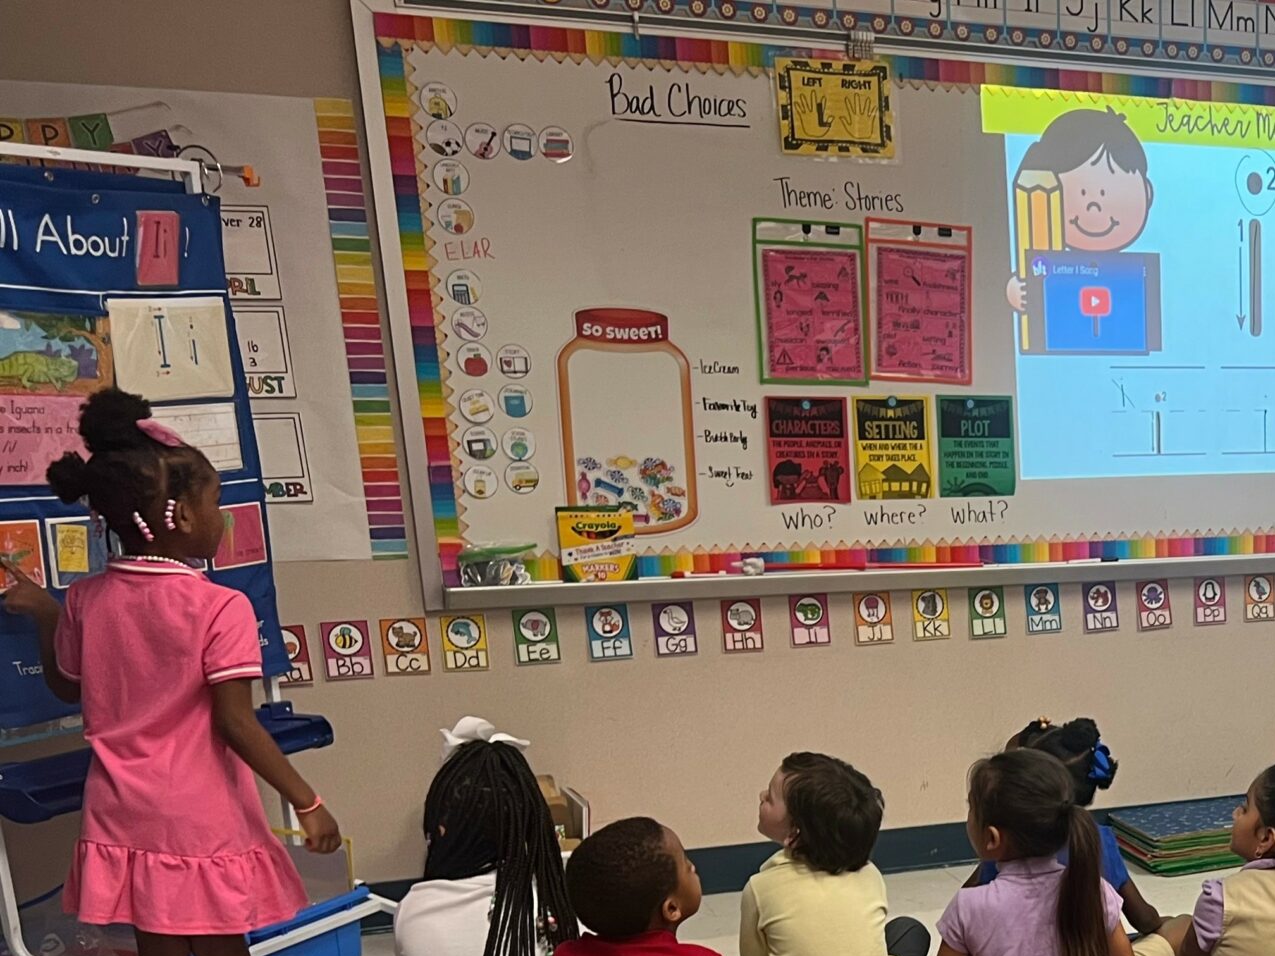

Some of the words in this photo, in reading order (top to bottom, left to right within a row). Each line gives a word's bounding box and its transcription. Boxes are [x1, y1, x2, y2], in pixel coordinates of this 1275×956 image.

[1119, 0, 1153, 25] Kk
[1208, 7, 1255, 33] Mm
[802, 76, 823, 88] LEFT
[841, 79, 873, 91] RIGHT
[605, 73, 661, 118] Bad
[667, 82, 749, 119] Choices
[1156, 102, 1252, 138] Teacher
[773, 176, 838, 210] Theme:
[844, 181, 904, 213] Stories
[249, 216, 263, 229] 28
[35, 213, 130, 257] About
[444, 237, 495, 261] ELAR
[1053, 265, 1074, 275] Letter
[1079, 265, 1099, 277] Song
[249, 357, 258, 368] 3
[10, 399, 46, 421] Iguana
[7, 419, 42, 434] insects
[55, 425, 63, 434] a
[771, 419, 841, 436] CHARACTERS
[865, 420, 919, 439] SETTING
[960, 420, 991, 437] PLOT
[861, 442, 878, 451] WHEN
[708, 464, 731, 480] Sweet
[575, 521, 617, 531] Crayola
[781, 505, 837, 531] Who?
[336, 657, 364, 676] Bb
[395, 654, 422, 672] Cc
[454, 650, 481, 669] Dd
[527, 644, 552, 662] Ee
[600, 639, 625, 657] Ff
[665, 636, 689, 654] Gg
[733, 633, 756, 650] Hh
[805, 627, 820, 645] Ii
[866, 624, 884, 643] Jj
[922, 620, 942, 637] Kk
[1030, 615, 1059, 631] Mm
[1093, 613, 1113, 628] Nn
[1146, 612, 1167, 628] Oo
[1203, 606, 1221, 623] Pp
[1250, 604, 1269, 620] Qq
